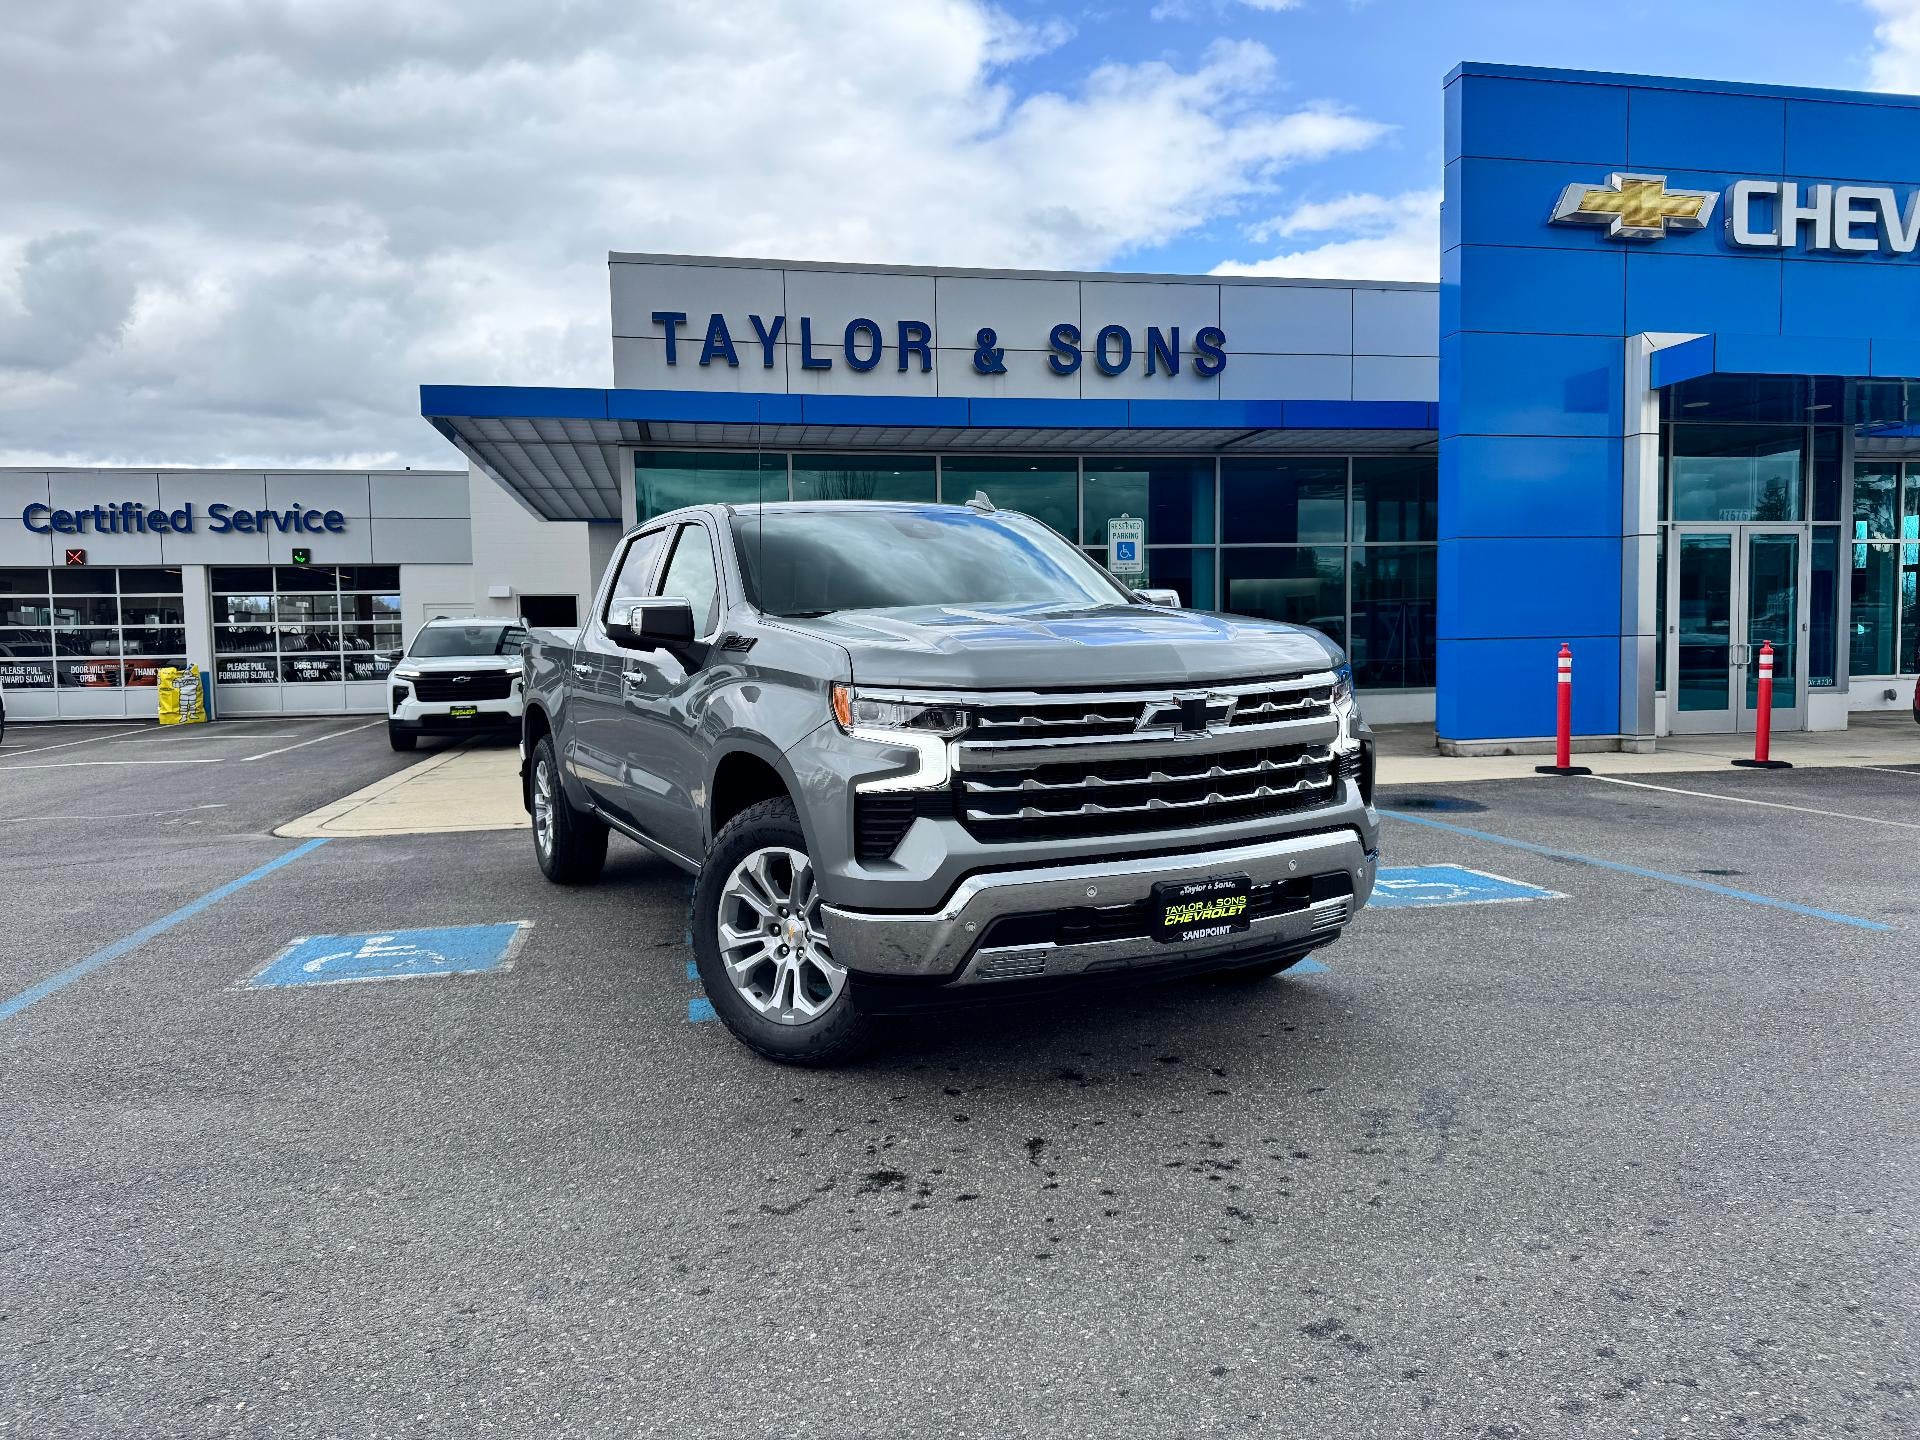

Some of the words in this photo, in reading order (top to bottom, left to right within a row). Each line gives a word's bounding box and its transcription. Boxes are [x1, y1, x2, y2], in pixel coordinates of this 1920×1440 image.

[651, 311, 933, 373] TAYLOR
[973, 327, 1008, 374] &
[1048, 323, 1227, 377] SONS
[22, 502, 194, 533] Certified
[207, 502, 346, 533] Service
[1111, 522, 1141, 530] RESERVED
[1112, 532, 1139, 540] PARKING
[1, 666, 26, 675] PLEASE
[27, 666, 43, 675] PULL
[71, 665, 89, 674] DOOR
[90, 665, 106, 674] WILL
[227, 662, 251, 671] PLEASE
[251, 662, 267, 671] PULL
[294, 662, 312, 670] DOOR
[354, 662, 374, 671] THANK
[134, 668, 155, 676] THANK
[218, 671, 249, 680] FORWARD
[250, 670, 275, 679] SLOWLY
[303, 670, 319, 678] OPEN
[26, 674, 51, 684] SLOWLY
[80, 674, 97, 683] OPEN
[1184, 884, 1206, 895] Taylor
[1214, 881, 1232, 890] Sons
[1165, 902, 1204, 915] TAYLOR
[1206, 901, 1214, 910] &
[1216, 895, 1247, 906] SONS
[1164, 905, 1246, 926] CHEVROLET
[1182, 925, 1232, 941] SANDPOINT
